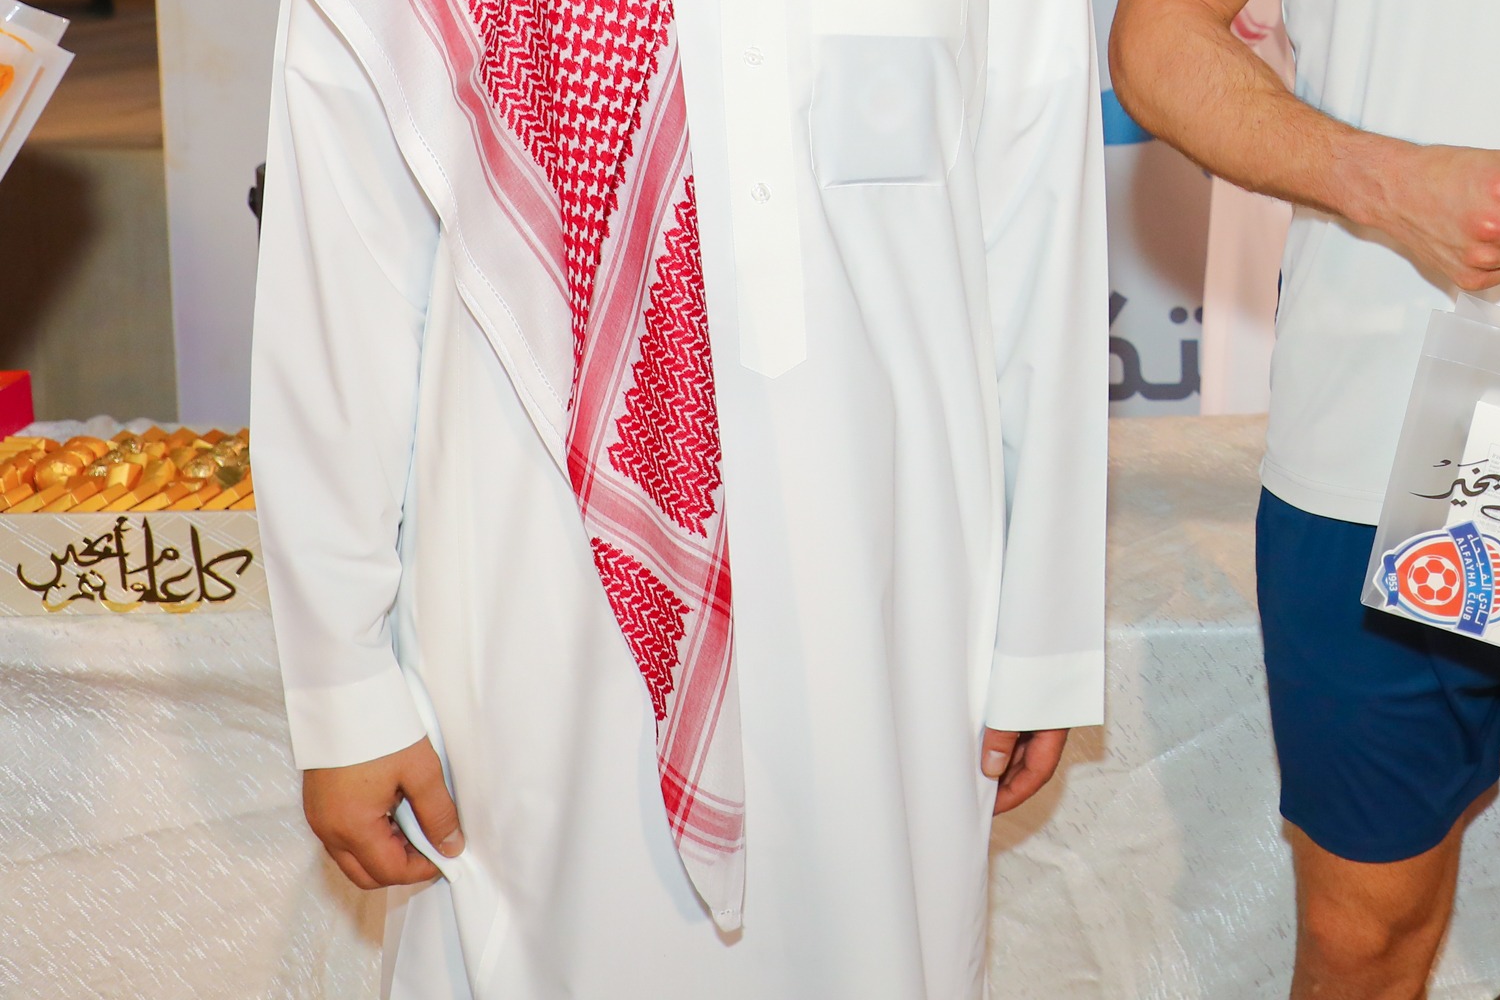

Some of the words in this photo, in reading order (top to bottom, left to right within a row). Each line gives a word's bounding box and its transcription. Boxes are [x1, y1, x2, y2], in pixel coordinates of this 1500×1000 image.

[1387, 572, 1398, 592] 1953
[1456, 536, 1477, 588] ALFAYHA
[1467, 533, 1492, 591] الفيحاء
[1462, 592, 1477, 621] CLUB
